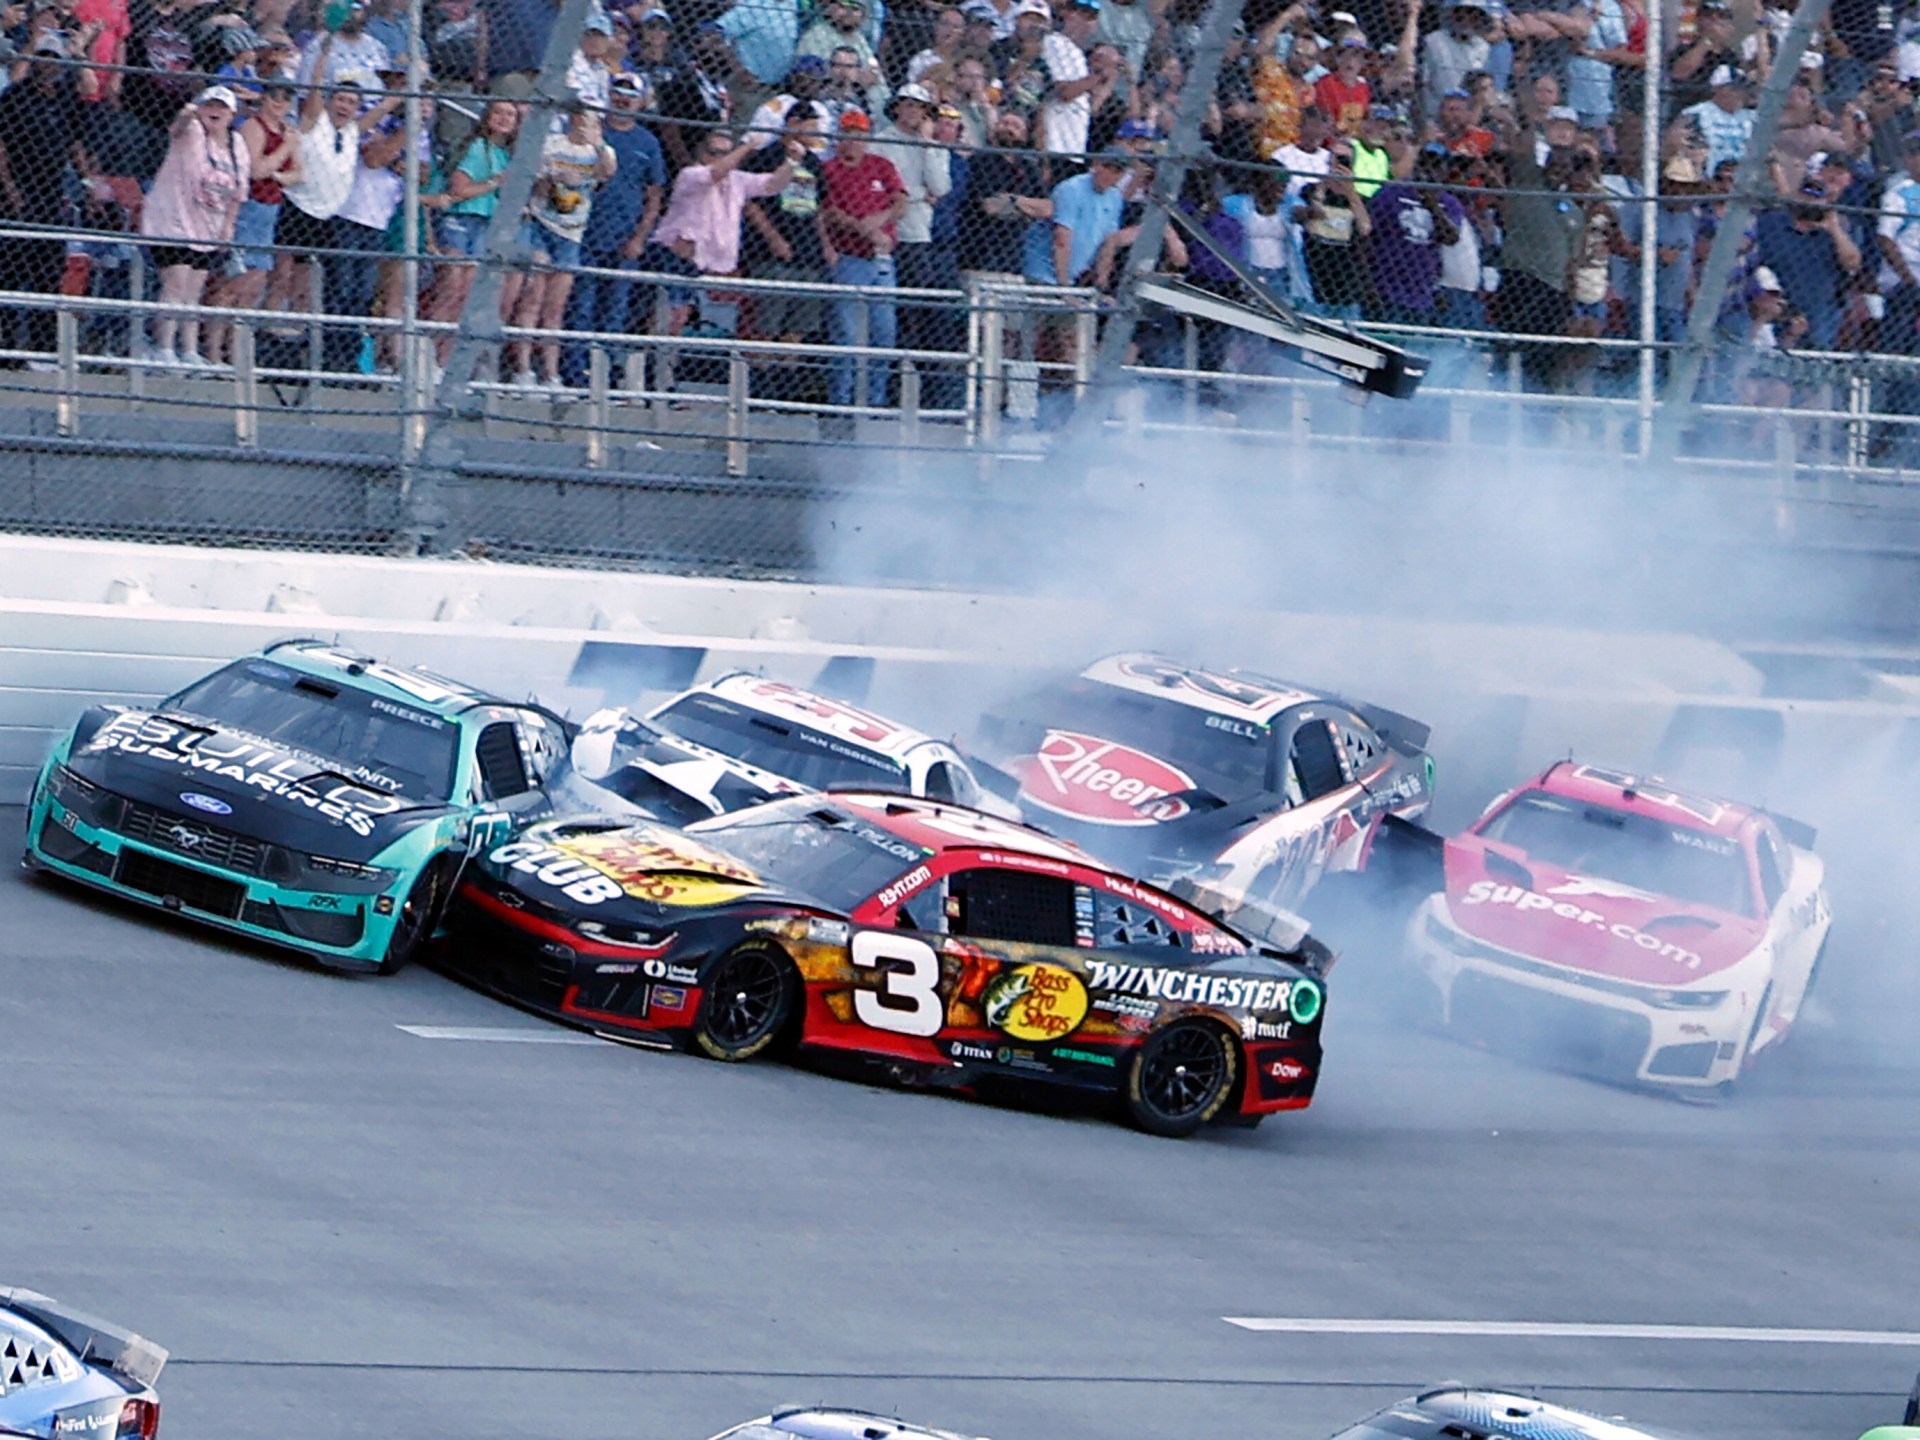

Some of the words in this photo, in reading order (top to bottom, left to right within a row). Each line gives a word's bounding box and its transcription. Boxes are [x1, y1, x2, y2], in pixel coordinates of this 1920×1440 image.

[371, 699, 444, 730] PREECE
[1204, 715, 1259, 739] BELL
[799, 731, 829, 749] VAN
[98, 711, 401, 814] BUILD
[1037, 731, 1183, 820] Rheem
[92, 732, 376, 837] SUBMARINES
[489, 842, 624, 905] CLUB
[1461, 880, 1702, 970] super.com
[851, 930, 943, 1039] 3
[1024, 988, 1057, 1011] Pro
[1030, 966, 1071, 992] Bass
[1084, 959, 1291, 1012] WINCHESTER
[1018, 1006, 1071, 1036] Shops
[963, 1046, 993, 1059] TITAN
